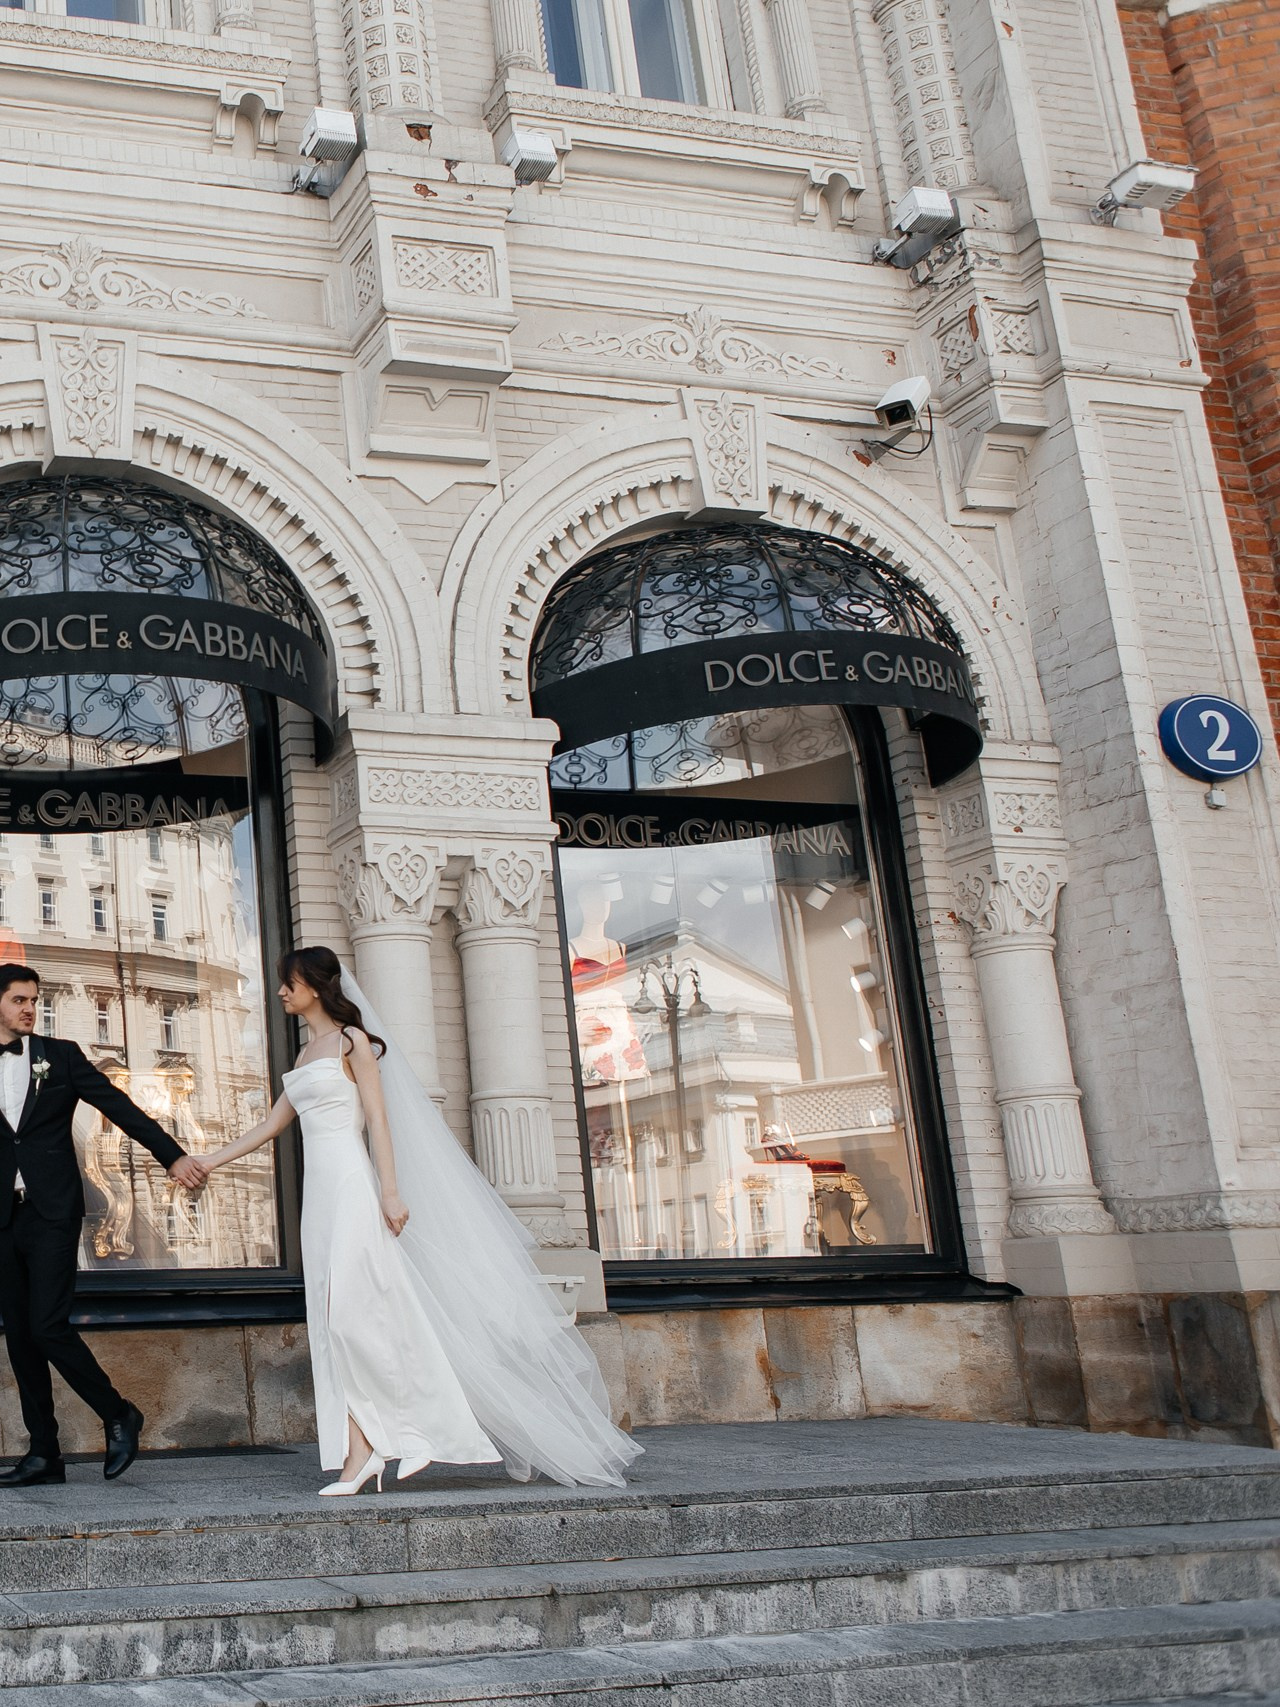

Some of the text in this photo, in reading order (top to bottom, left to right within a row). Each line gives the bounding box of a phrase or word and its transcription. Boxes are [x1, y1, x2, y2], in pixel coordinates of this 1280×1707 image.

[116, 631, 132, 649] &
[139, 614, 308, 685] GABBANA
[704, 649, 977, 708] DOLCE & GABBAN
[1198, 710, 1236, 761] 2
[554, 811, 662, 848] DOLCE
